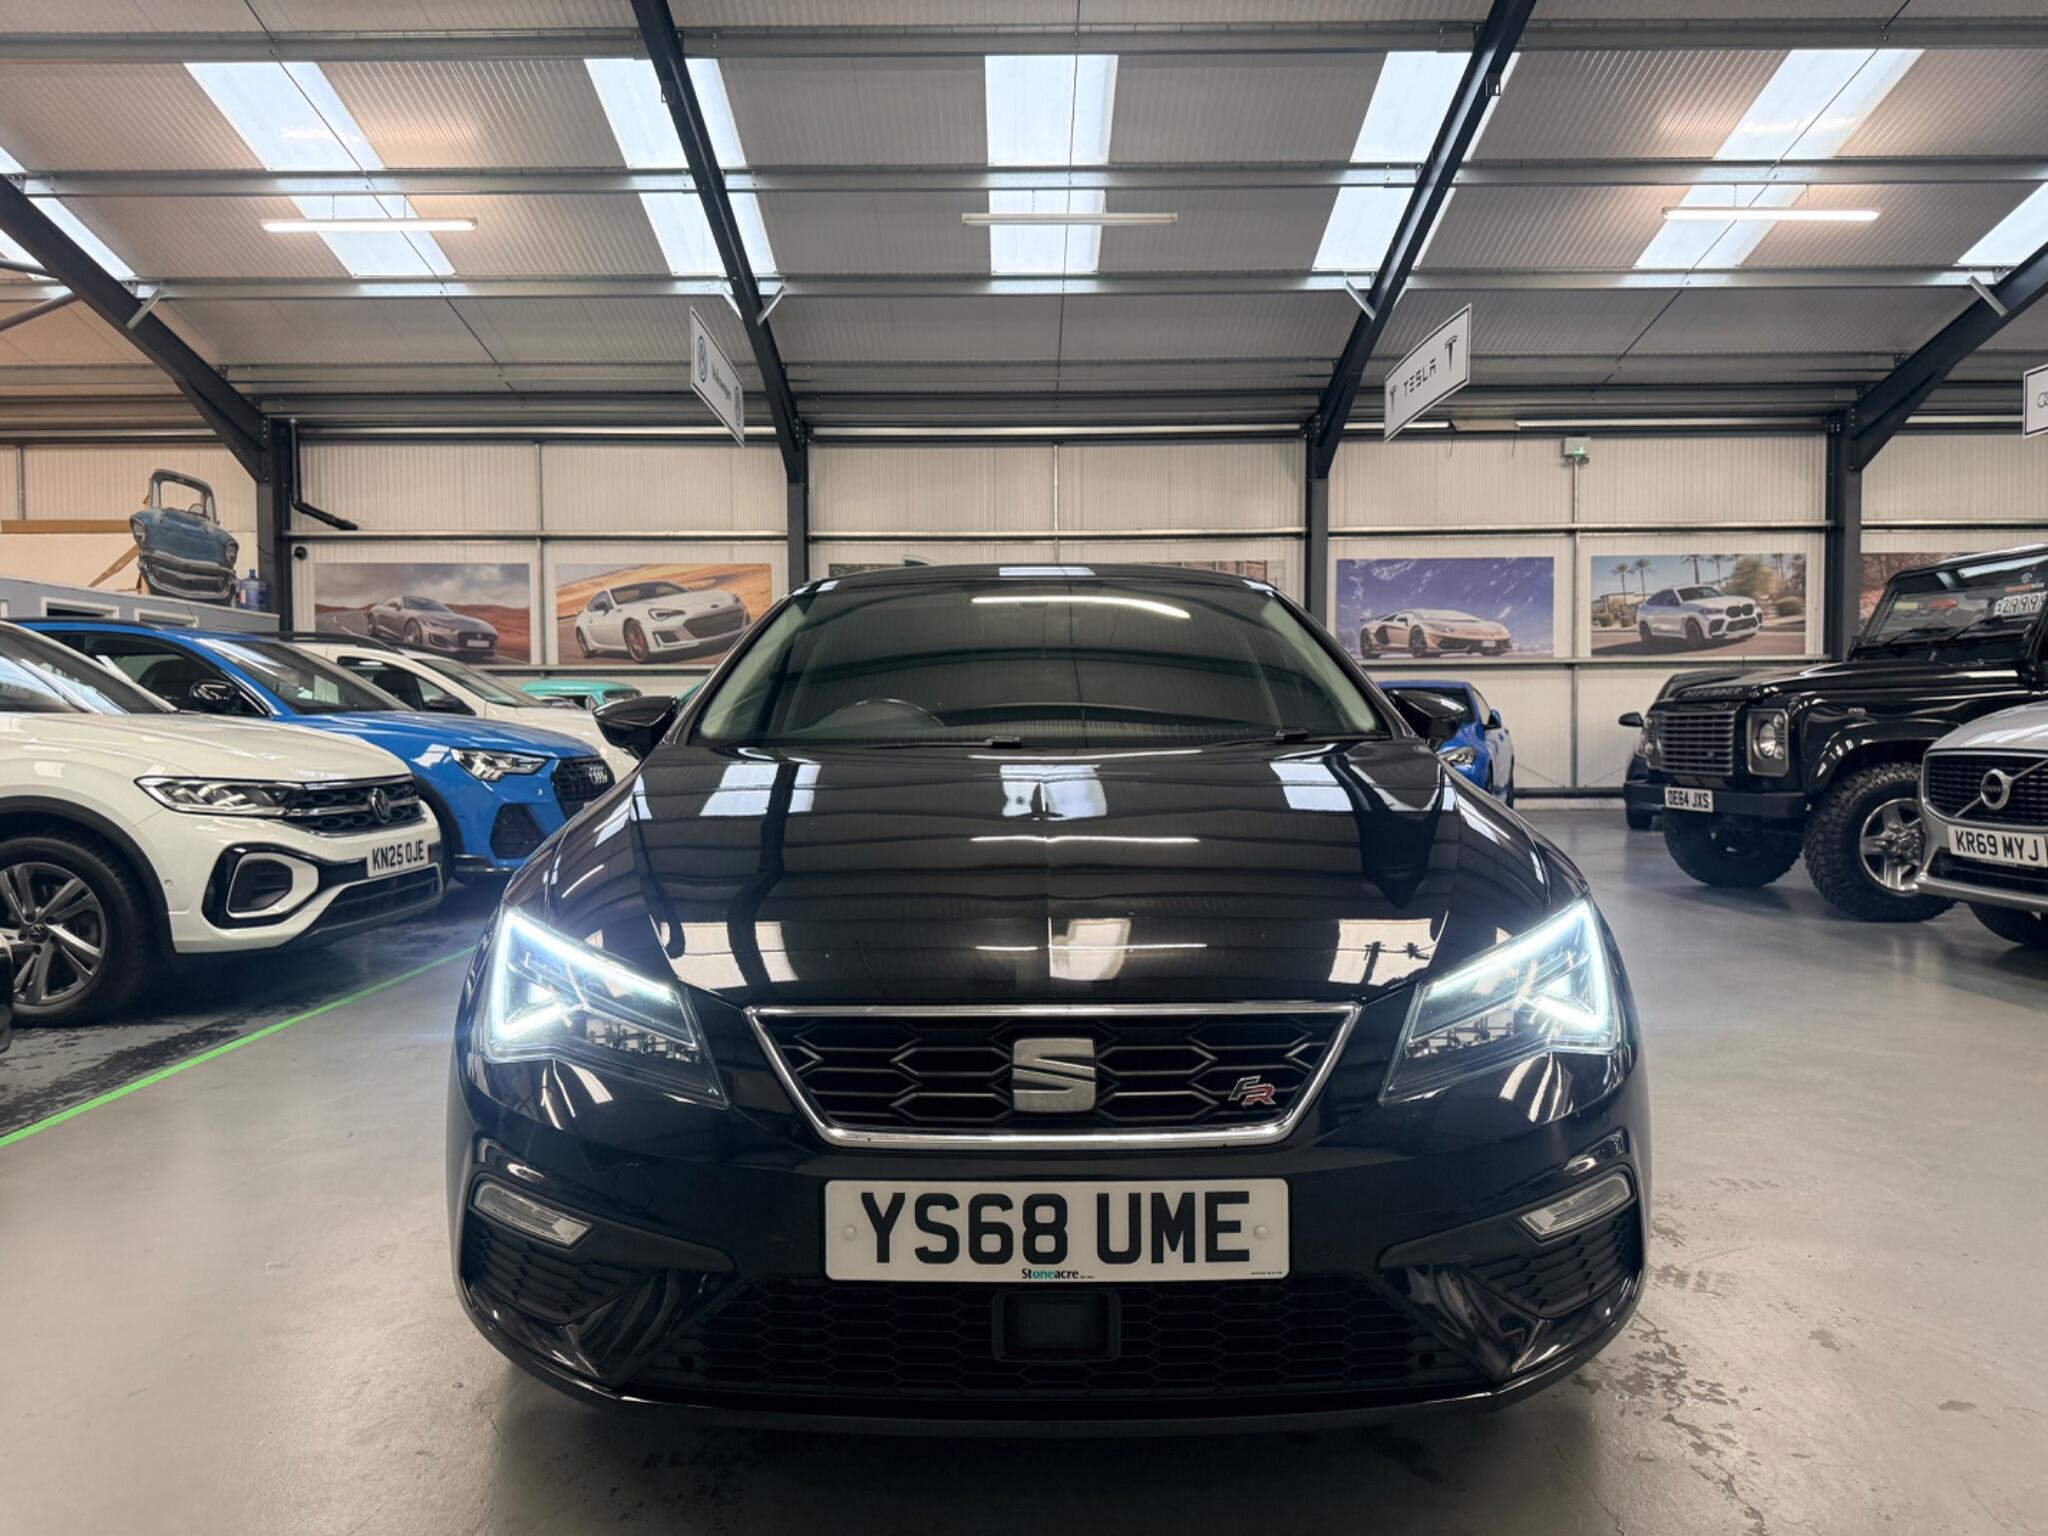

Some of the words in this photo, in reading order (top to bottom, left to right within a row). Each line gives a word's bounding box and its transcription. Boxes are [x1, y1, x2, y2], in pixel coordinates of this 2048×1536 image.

[1403, 358, 1437, 397] TESLA
[372, 844, 404, 871] KN25
[405, 839, 424, 863] OJE
[1955, 829, 1998, 856] KR69
[2001, 835, 2039, 861] MYJ
[1227, 1075, 1276, 1106] FR
[860, 1191, 1068, 1264] YS68
[1096, 1190, 1250, 1264] UME
[1021, 1268, 1079, 1279] Stoneacre
